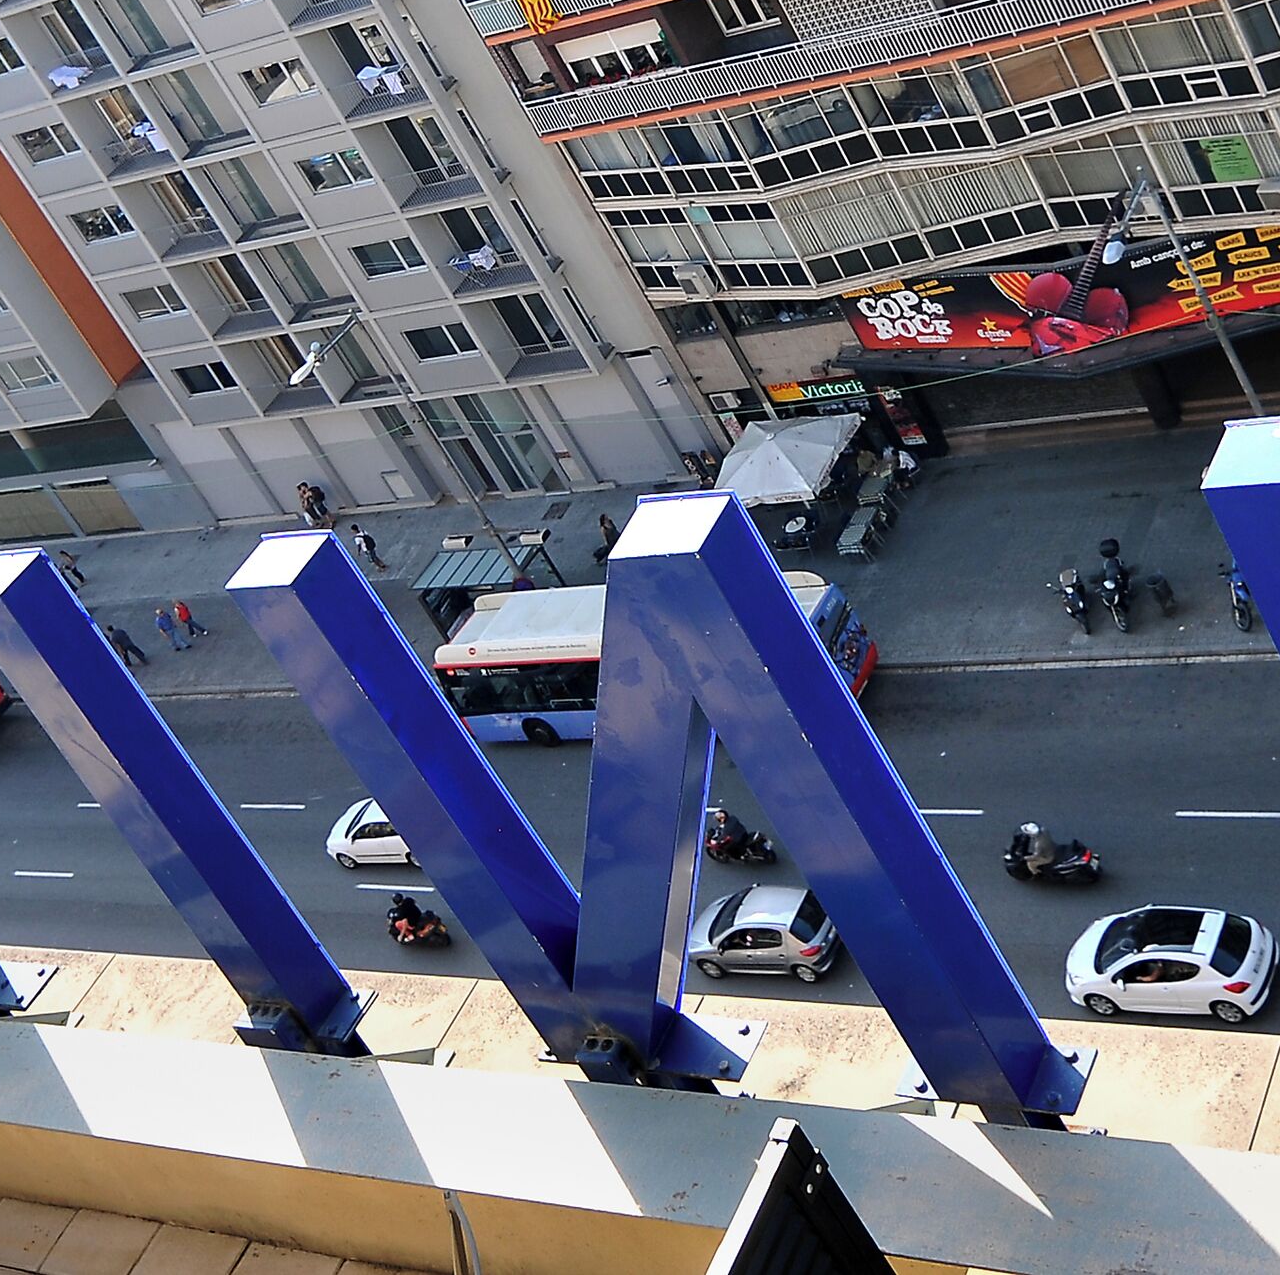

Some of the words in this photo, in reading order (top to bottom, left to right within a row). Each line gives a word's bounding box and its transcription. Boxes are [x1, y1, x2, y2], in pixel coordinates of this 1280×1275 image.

[1130, 256, 1152, 270] Amb
[1152, 245, 1191, 263] canços
[857, 290, 920, 318] COP
[921, 298, 945, 314] de
[867, 313, 953, 340] ROCK
[774, 493, 803, 502] VICTORIA
